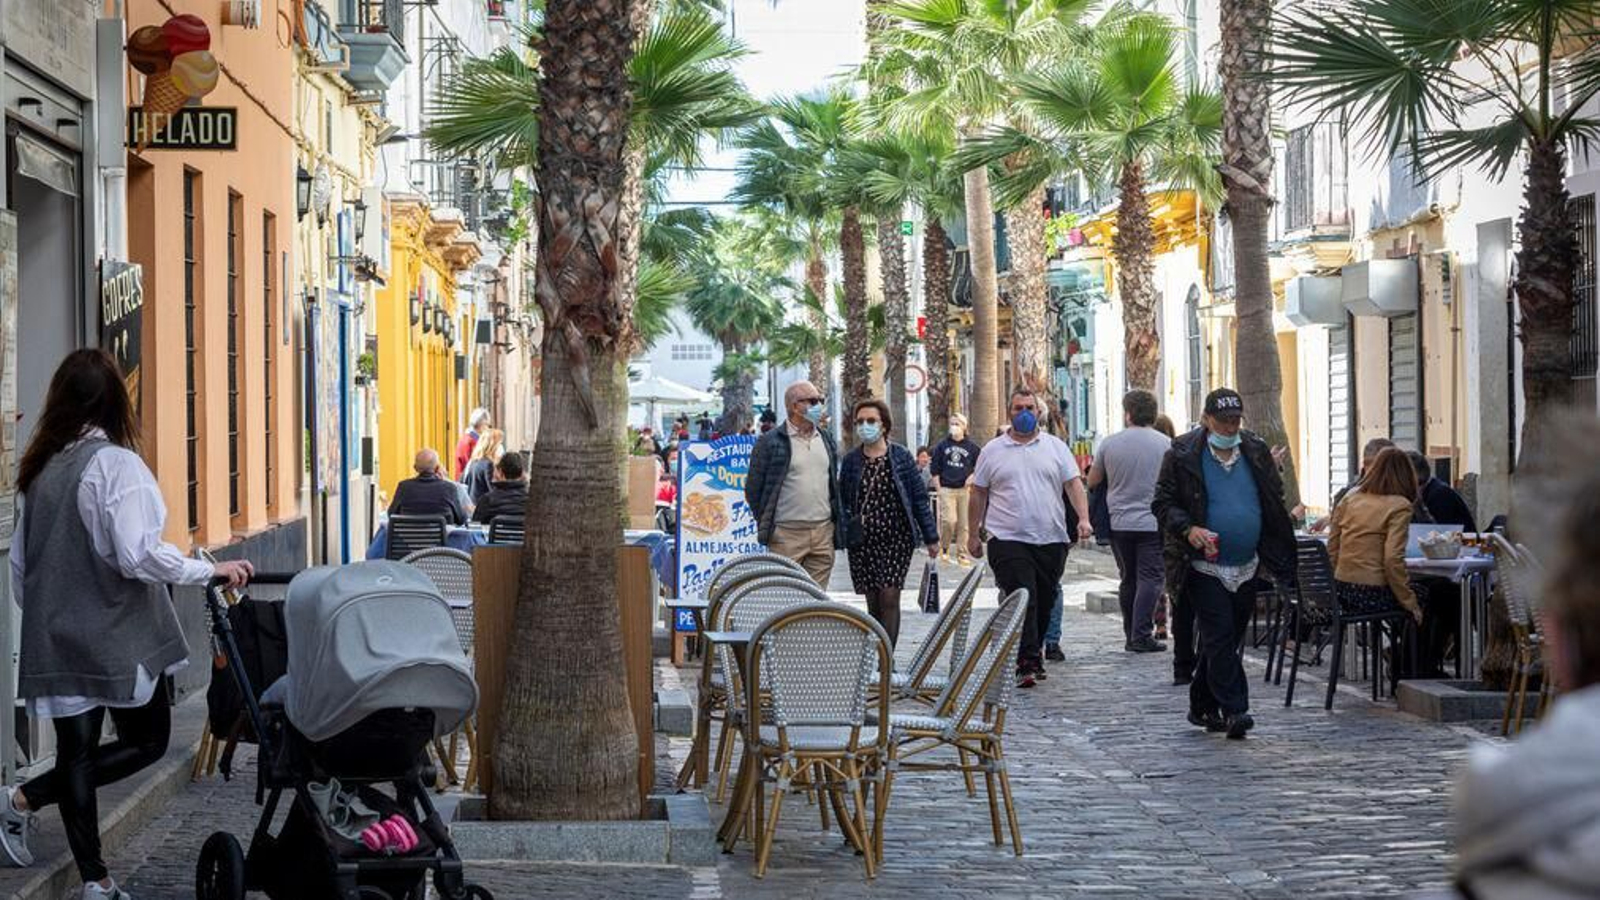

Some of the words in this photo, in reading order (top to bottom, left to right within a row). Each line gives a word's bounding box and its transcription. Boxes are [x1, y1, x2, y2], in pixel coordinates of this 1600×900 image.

[133, 112, 232, 144] HELADO
[102, 264, 143, 325] GOFRES
[1217, 397, 1240, 409] NYC
